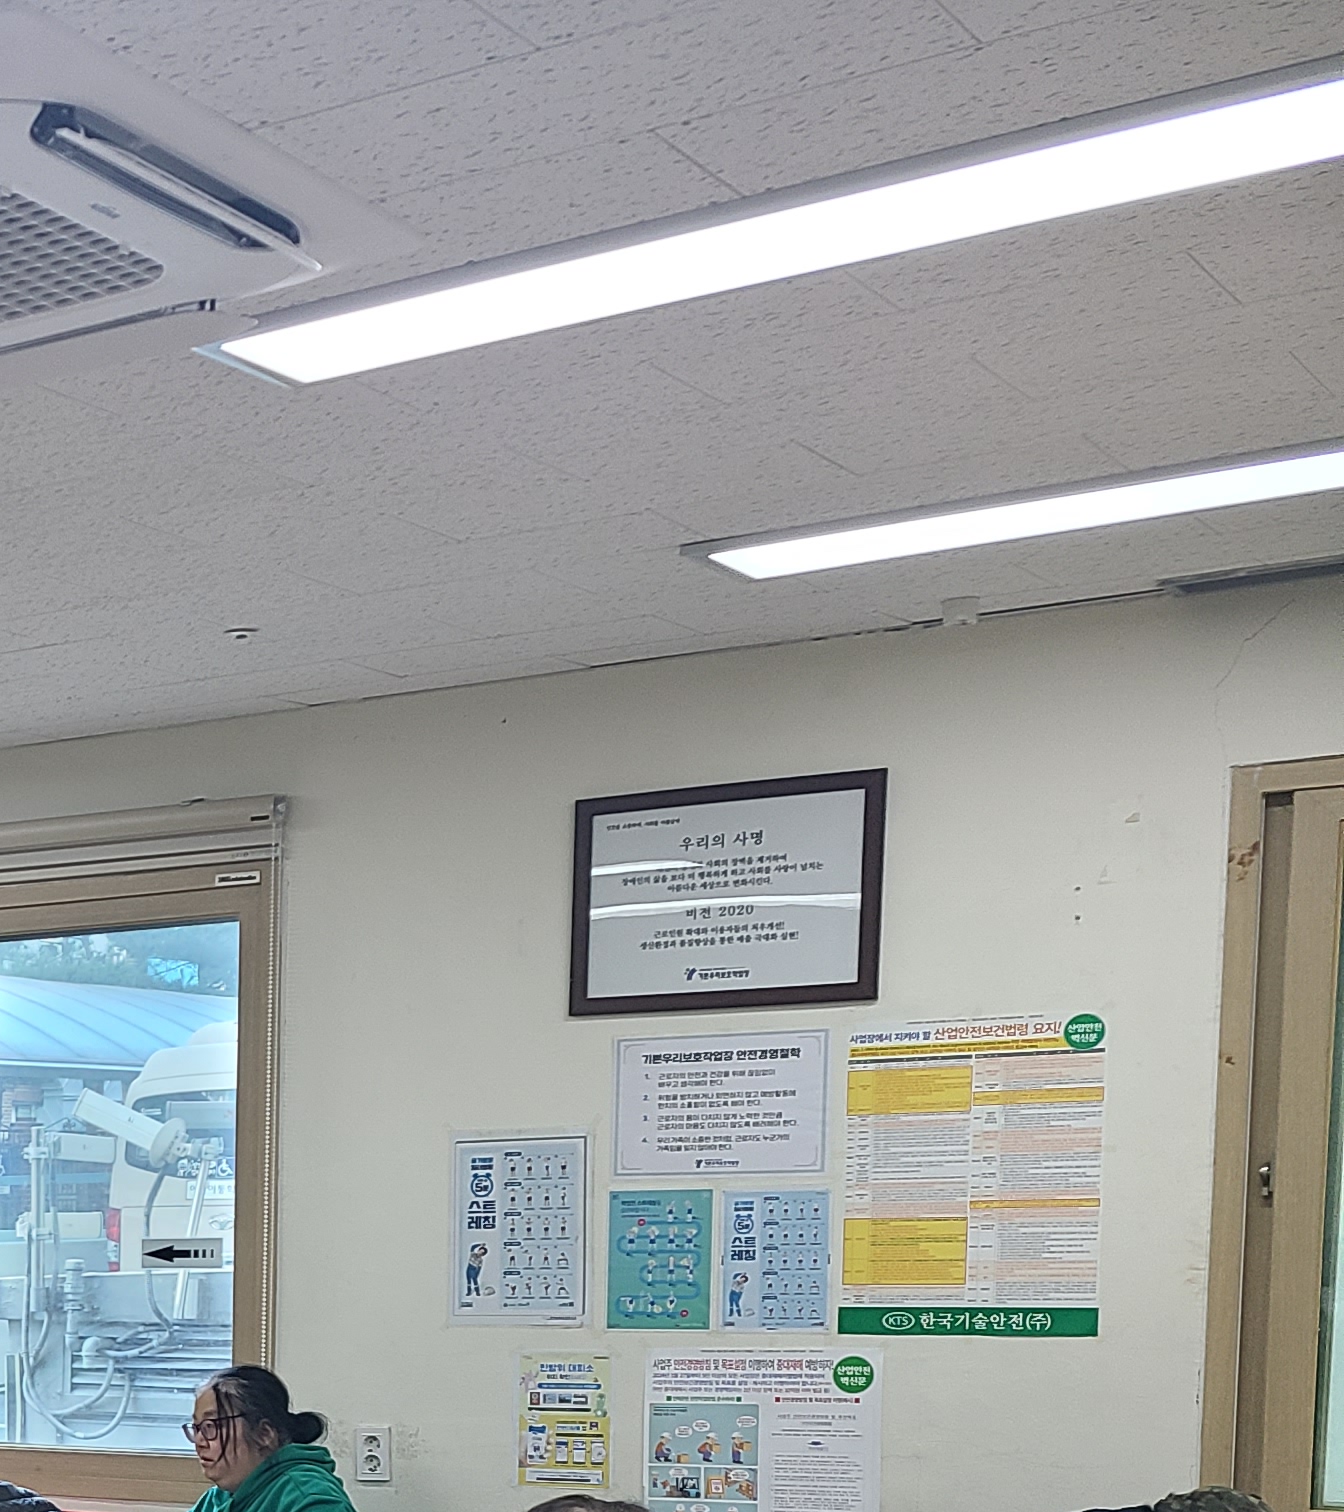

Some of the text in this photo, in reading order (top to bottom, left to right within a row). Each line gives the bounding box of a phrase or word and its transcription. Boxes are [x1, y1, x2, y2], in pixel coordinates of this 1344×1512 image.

[679, 829, 764, 851] 우리의 사명
[685, 904, 754, 920] 비전 2020
[933, 1022, 1028, 1041] 산업안전보건법령
[1032, 1021, 1062, 1035] 요지!
[467, 1200, 496, 1214] 스트
[467, 1215, 497, 1230] 레칭
[731, 1236, 756, 1249] 스트
[731, 1248, 756, 1261] 레칭
[888, 1312, 1052, 1331] KTS 한국기술안전(주)
